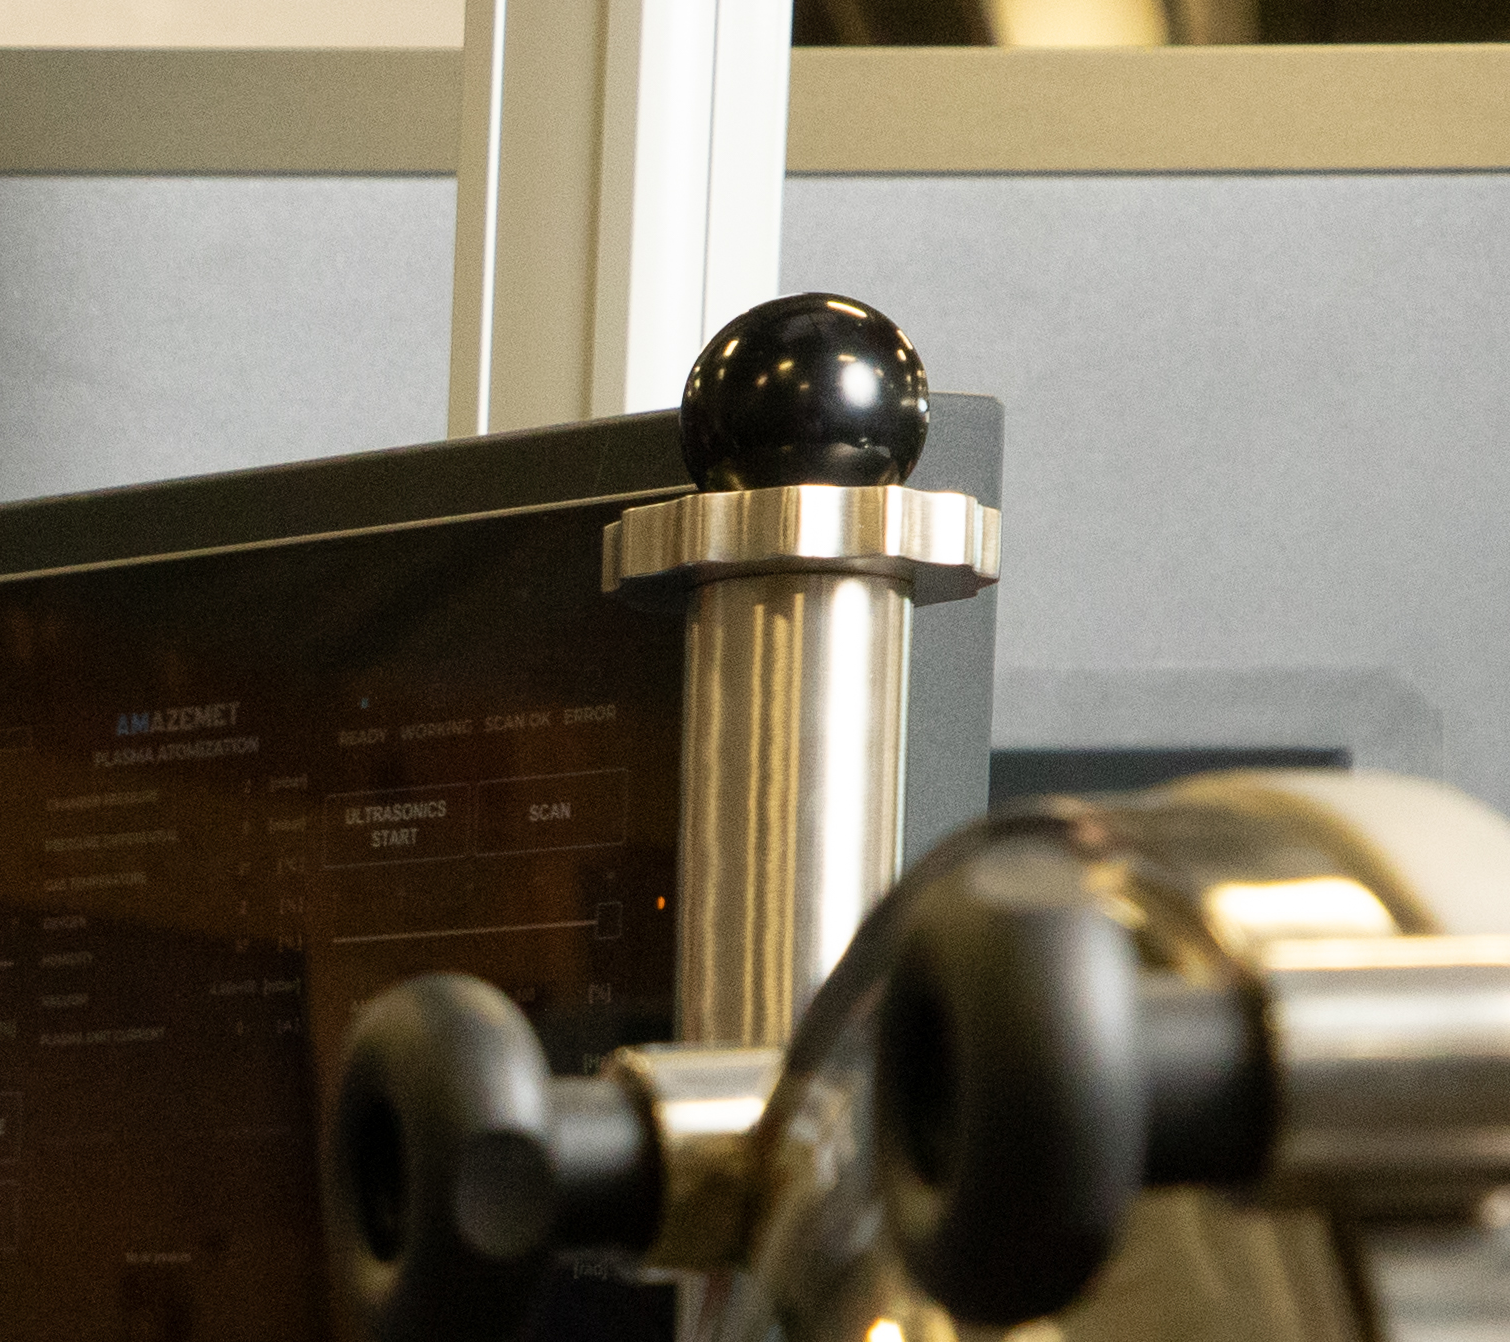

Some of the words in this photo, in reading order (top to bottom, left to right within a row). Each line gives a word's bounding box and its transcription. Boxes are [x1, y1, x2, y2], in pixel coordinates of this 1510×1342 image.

[116, 701, 241, 736] AMAZEMET
[484, 713, 525, 733] SCAN
[528, 711, 552, 728] OK
[563, 704, 617, 725] ERROR
[400, 719, 473, 740] WORKING
[93, 746, 154, 768] PLASMA
[157, 736, 260, 762] ATOMIZATION
[345, 800, 447, 825] ULTRASONICS
[528, 802, 571, 822] SCAN
[371, 828, 420, 848] START
